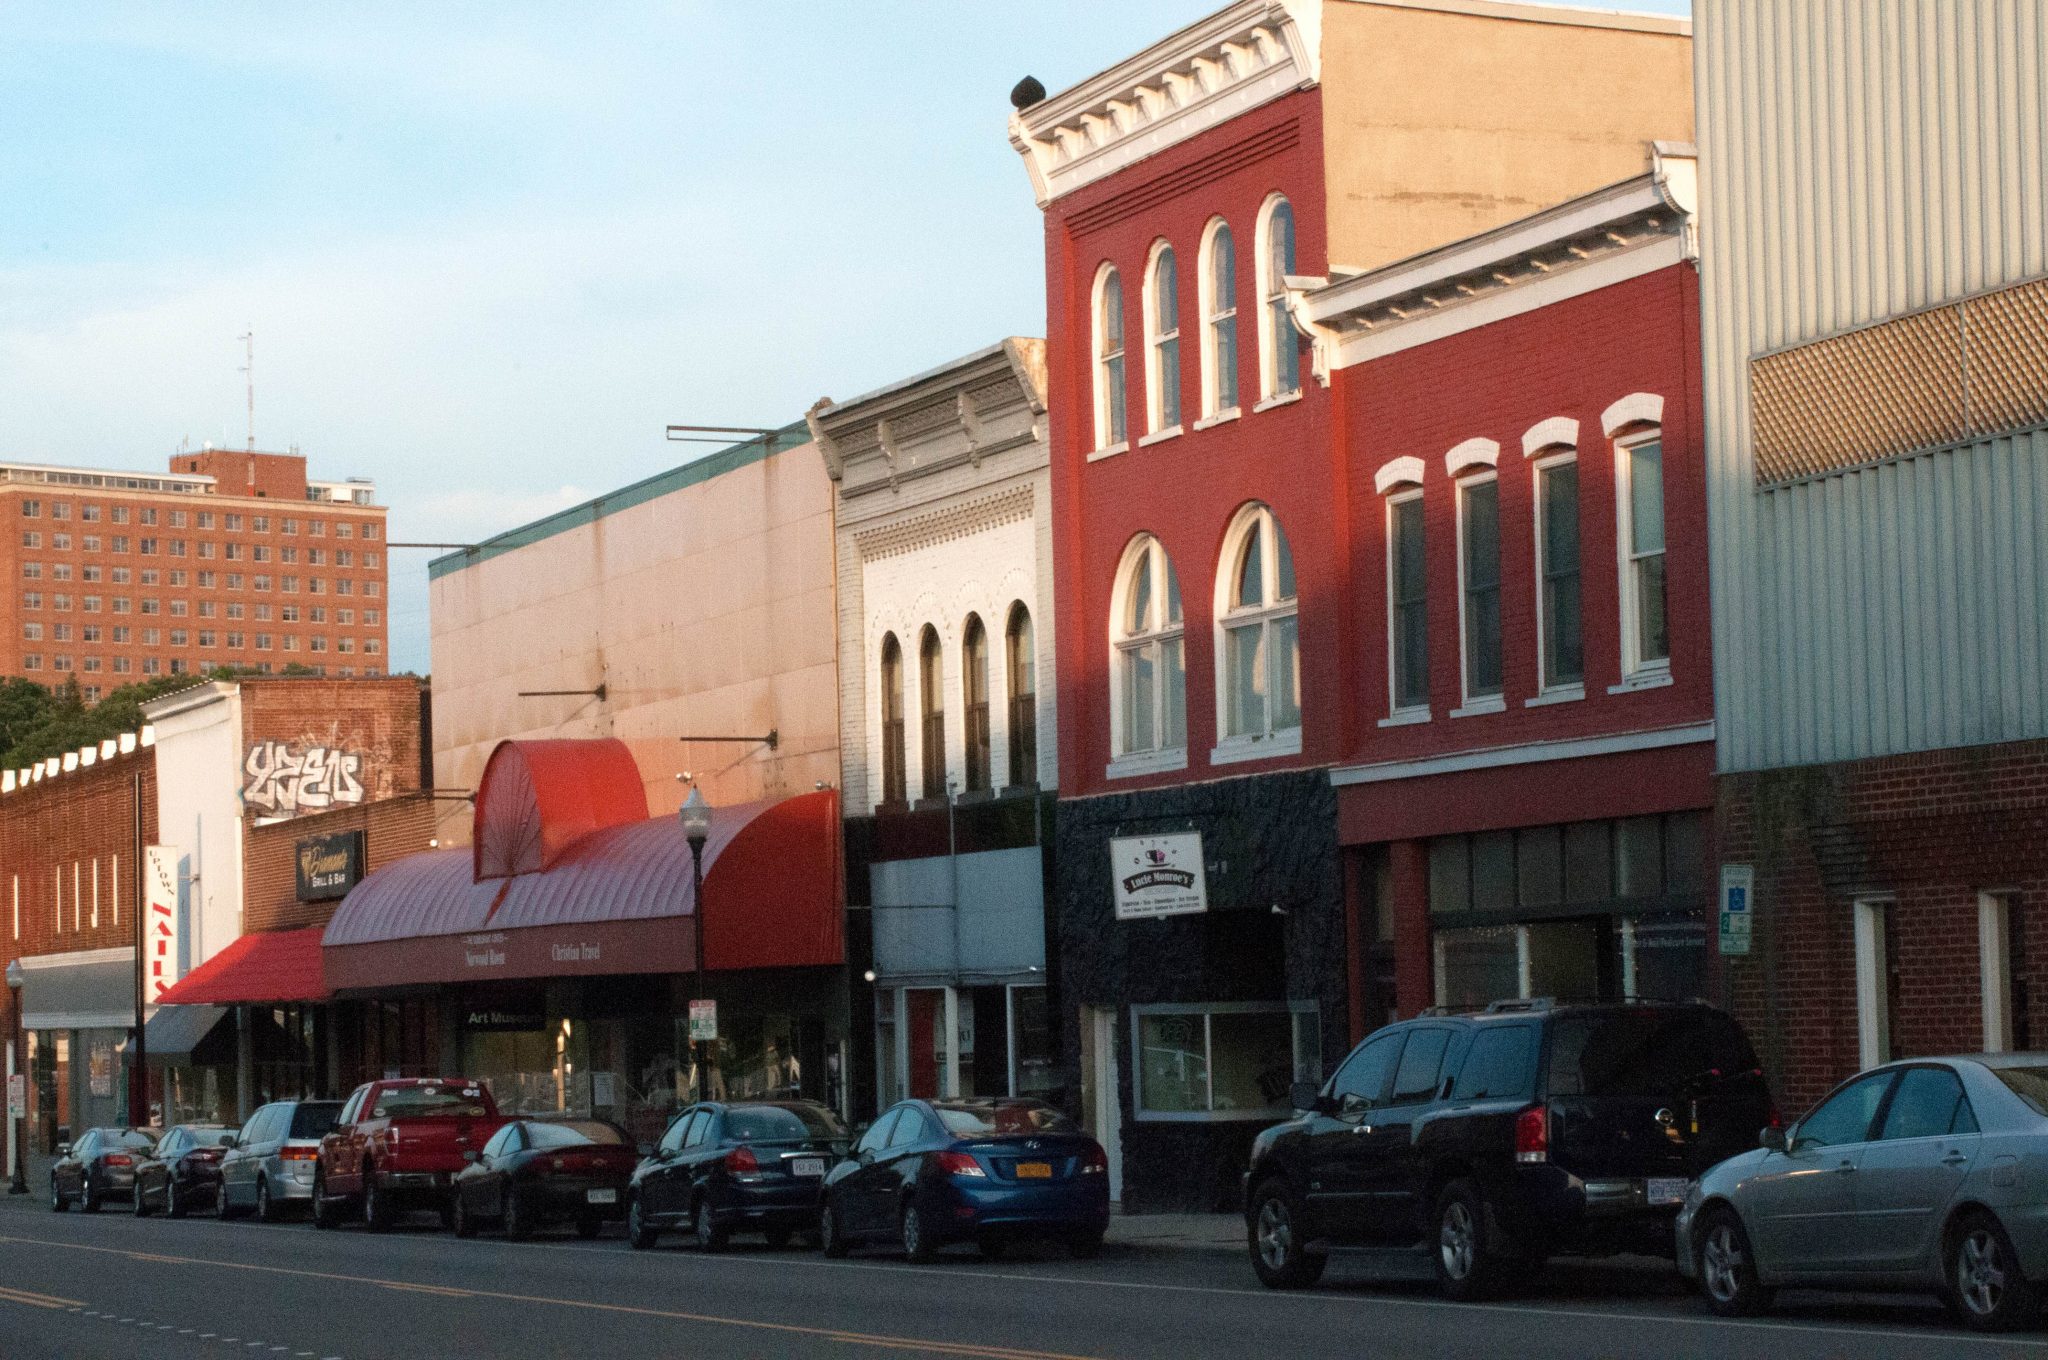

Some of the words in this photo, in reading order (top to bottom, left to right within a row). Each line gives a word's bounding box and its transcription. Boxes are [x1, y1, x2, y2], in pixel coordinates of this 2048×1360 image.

[149, 850, 175, 896] UPTOWN
[580, 942, 601, 960] Travel
[468, 1011, 489, 1024] Art
